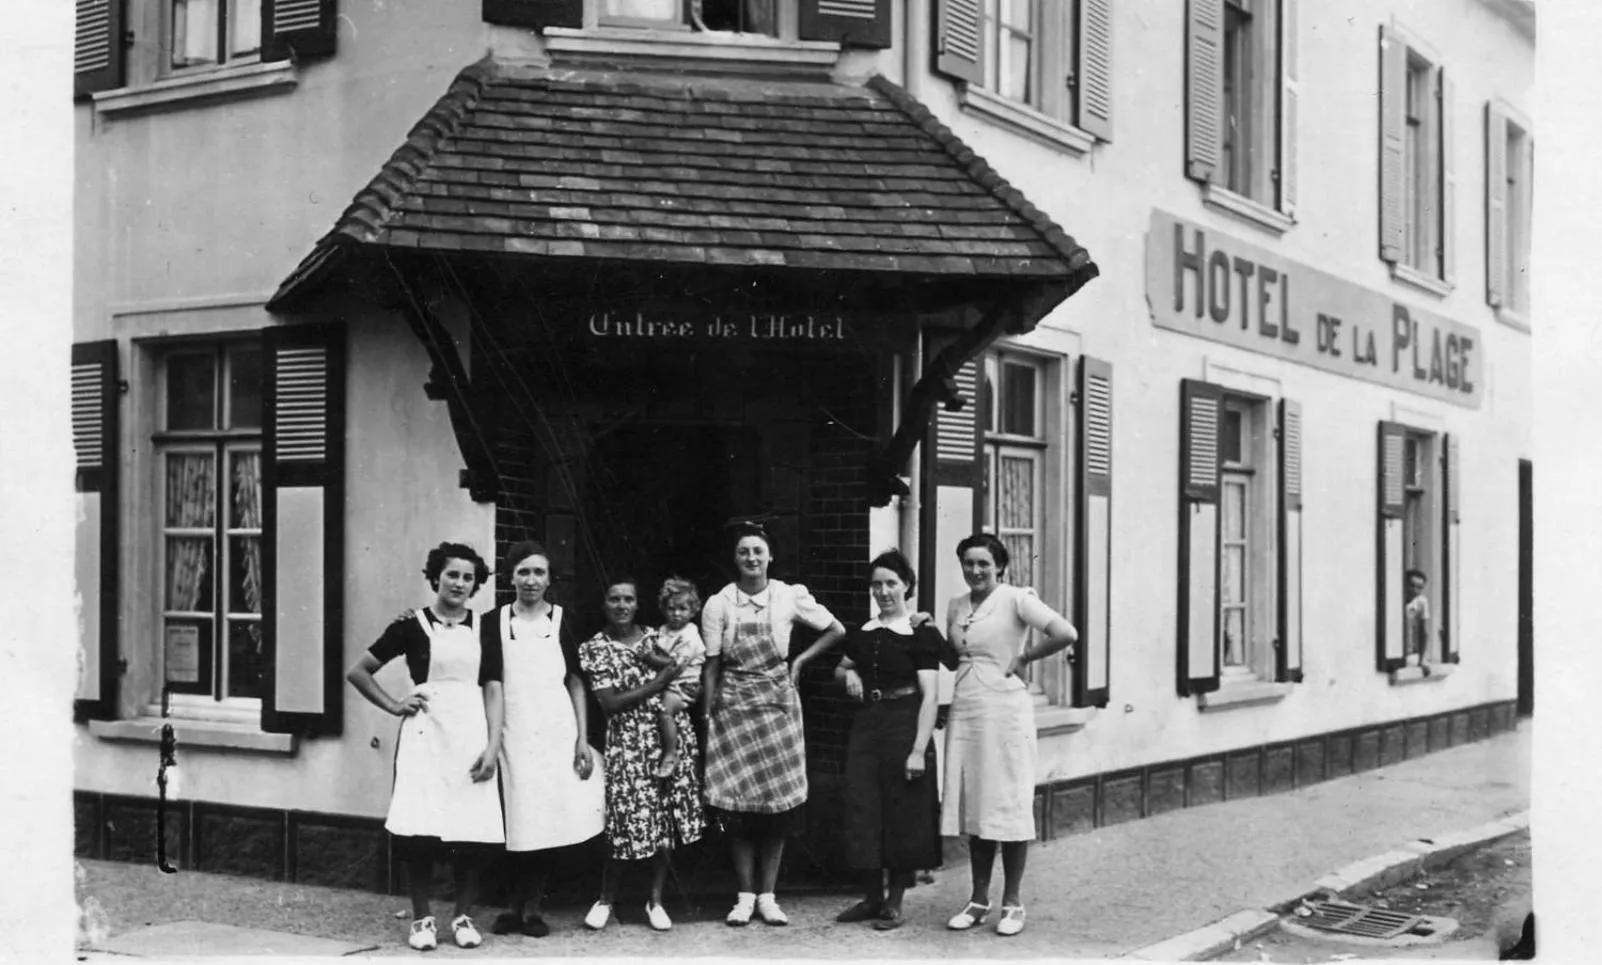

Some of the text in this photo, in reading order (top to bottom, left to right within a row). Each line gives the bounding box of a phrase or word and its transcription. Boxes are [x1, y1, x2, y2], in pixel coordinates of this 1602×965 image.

[707, 316, 738, 336] de
[1174, 222, 1474, 393] HOTEL DE LA PLAGE
